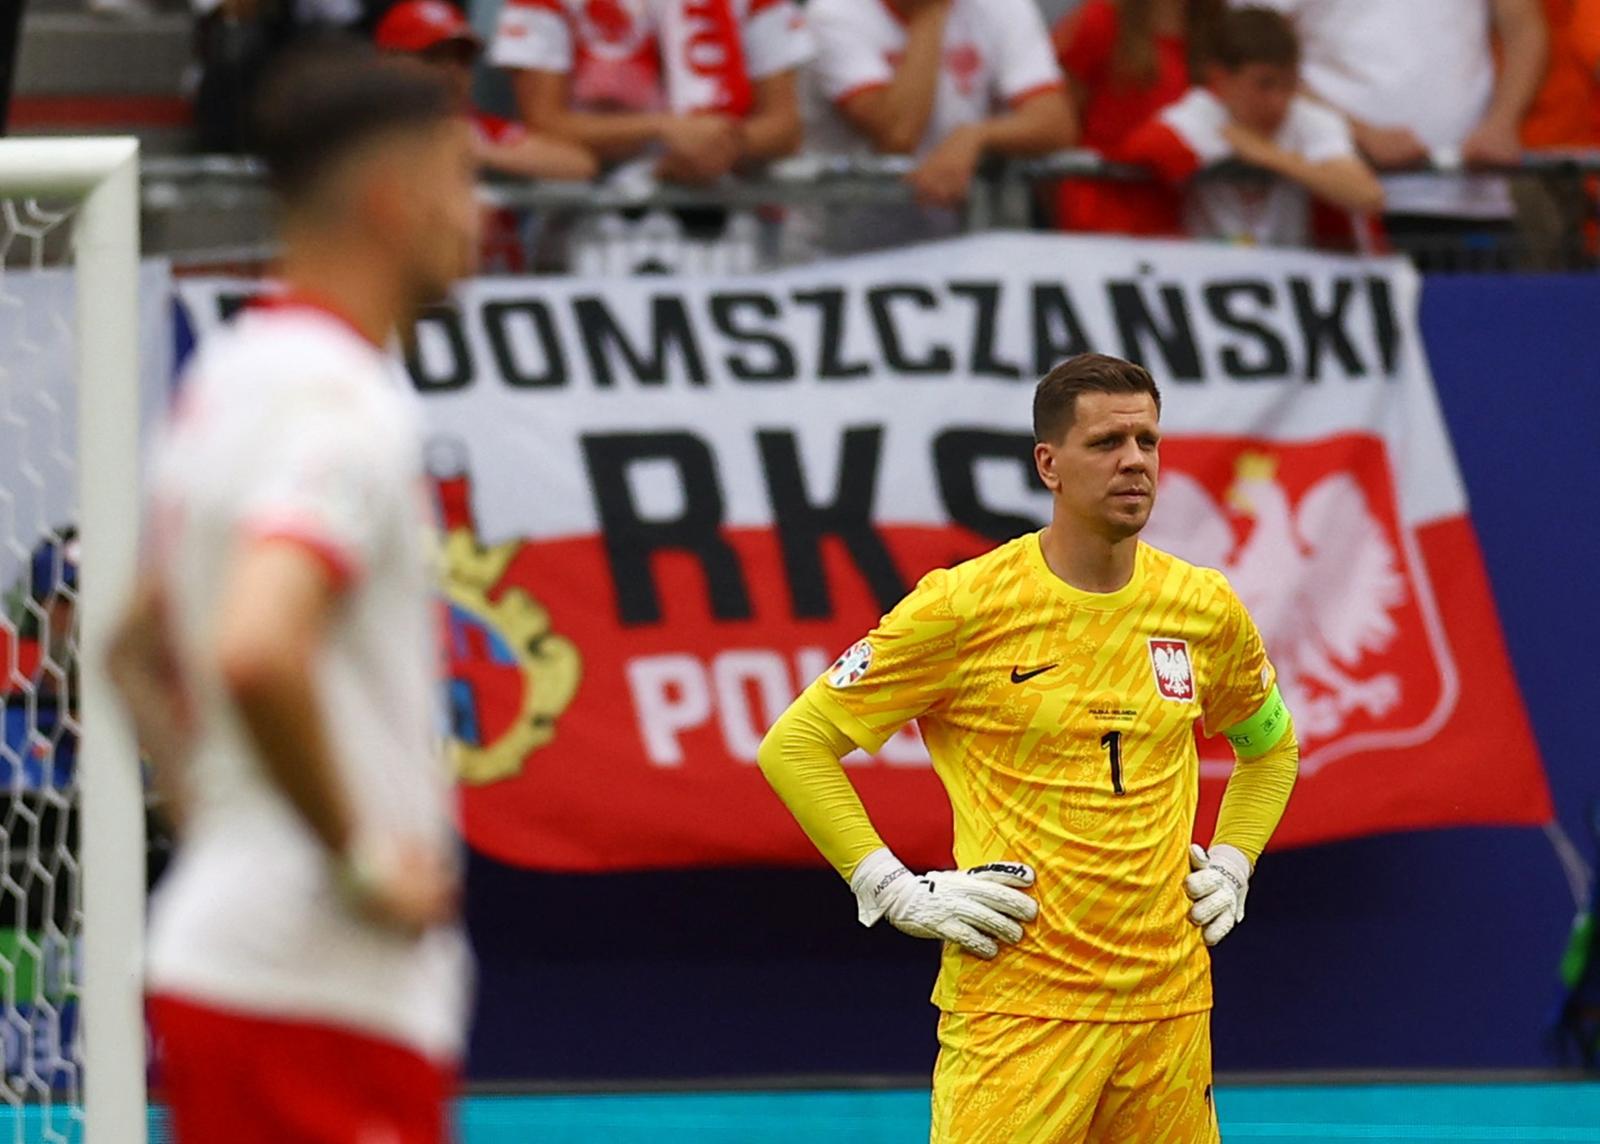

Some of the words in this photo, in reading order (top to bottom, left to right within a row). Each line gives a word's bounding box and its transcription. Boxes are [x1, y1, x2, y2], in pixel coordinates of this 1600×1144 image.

[218, 259, 1401, 392] DOMSZCZAŃSKI
[579, 426, 1041, 626] RKS
[1101, 730, 1125, 795] 1
